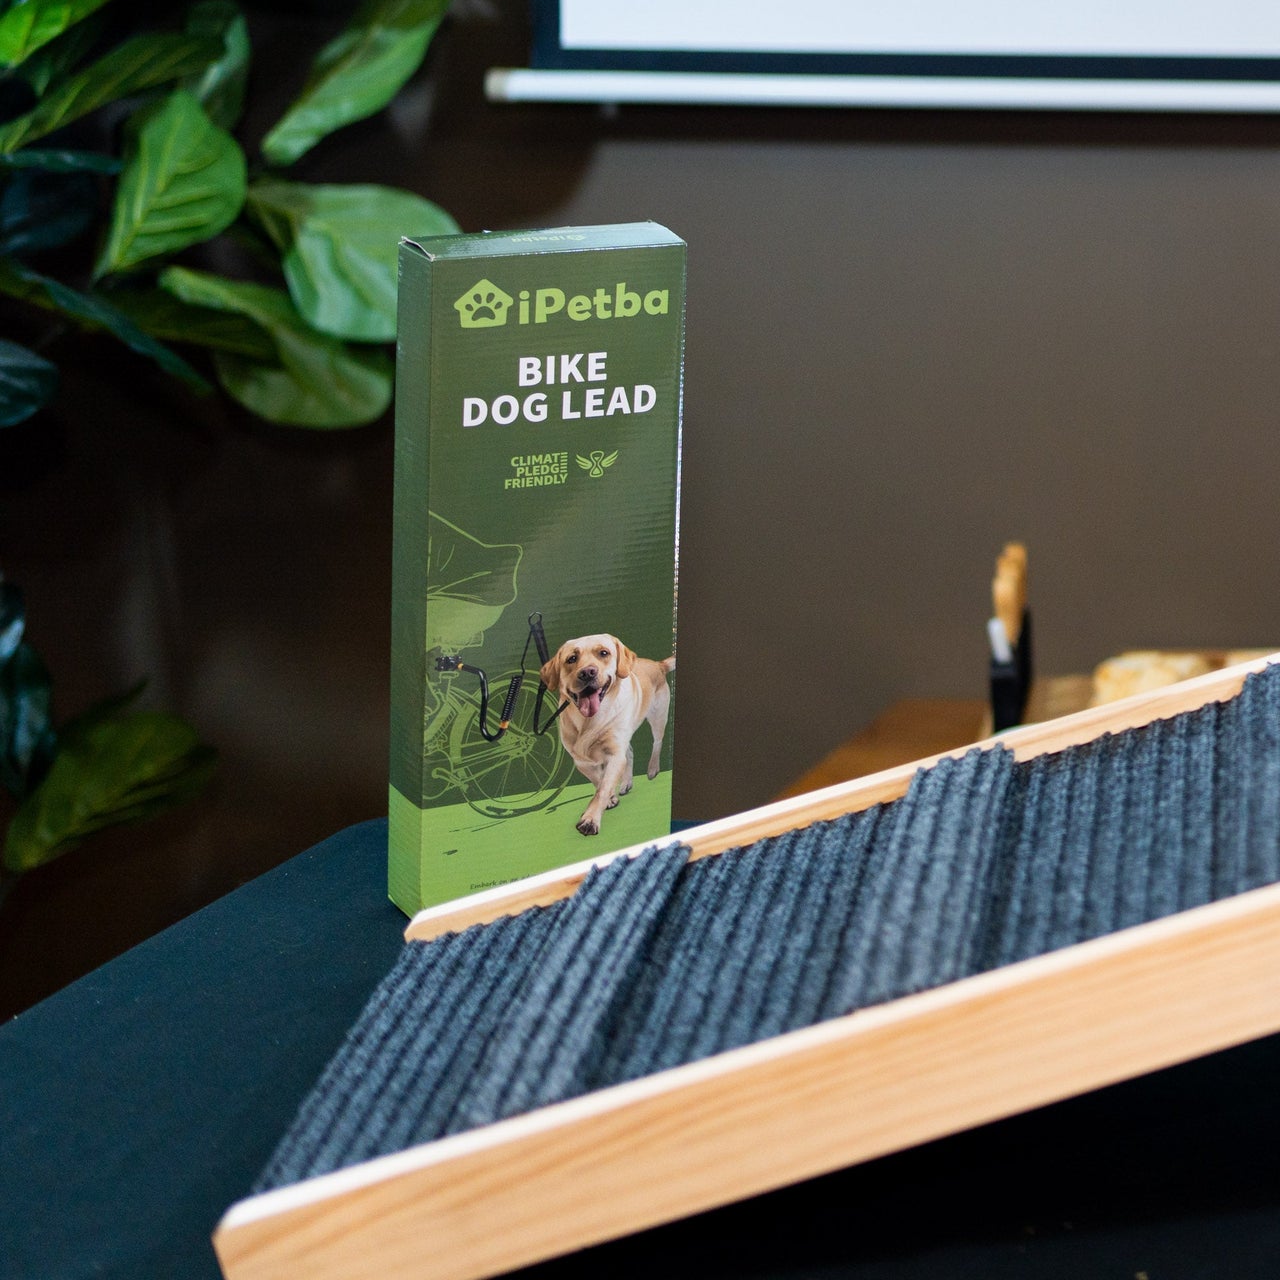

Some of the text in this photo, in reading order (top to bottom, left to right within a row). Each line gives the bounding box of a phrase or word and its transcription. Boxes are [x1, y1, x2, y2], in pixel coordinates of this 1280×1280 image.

[518, 281, 669, 325] iPetba
[518, 352, 608, 387] BIKE
[463, 384, 657, 428] DOG LEAD
[511, 452, 568, 468] CLIMATE
[516, 463, 568, 477] PLEDGE
[504, 473, 569, 490] FRIENDLY
